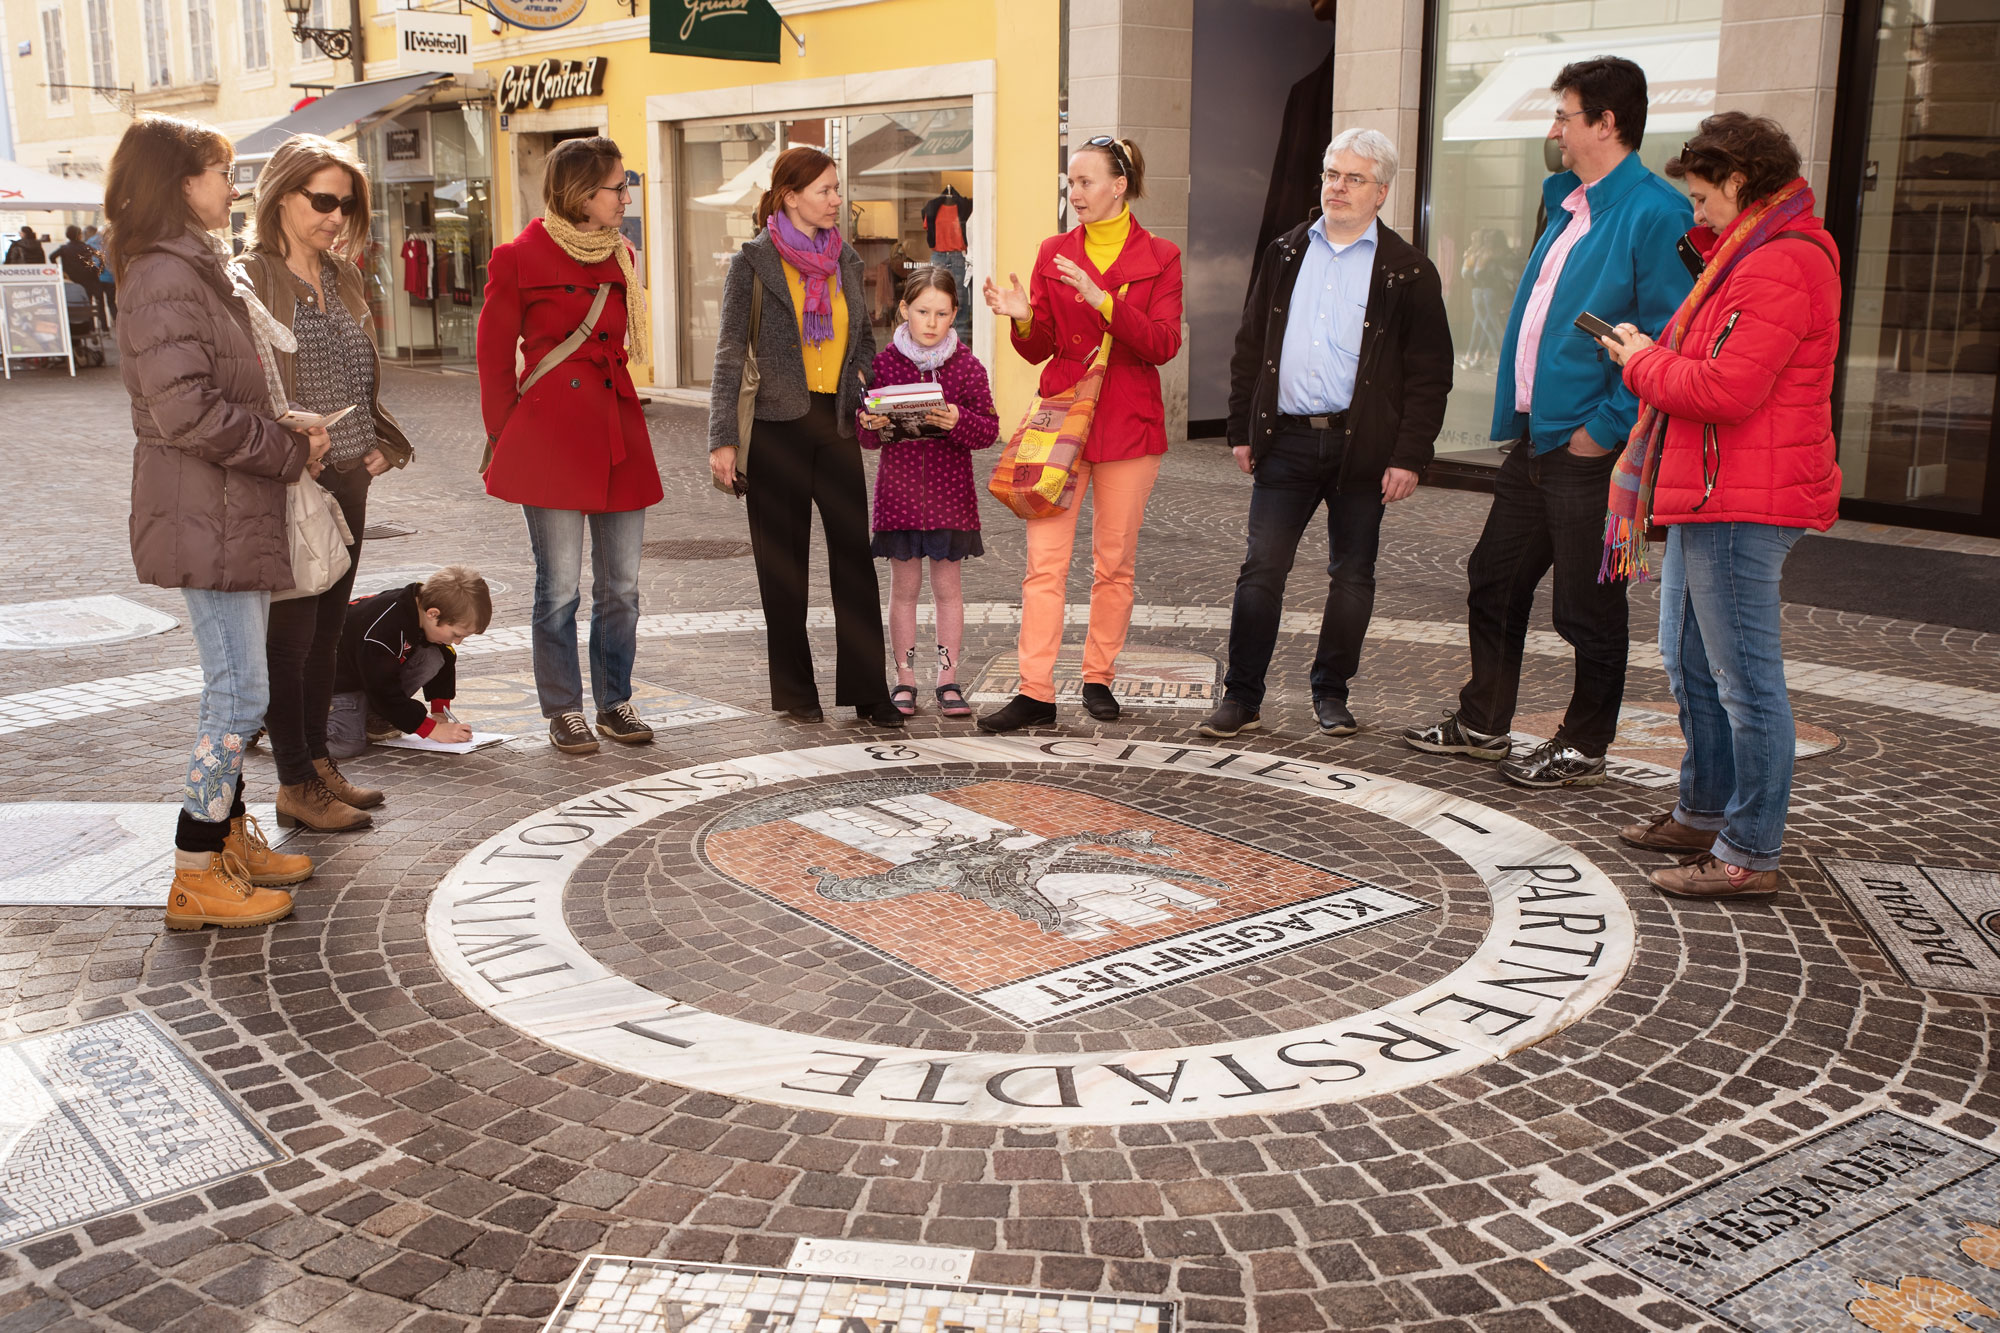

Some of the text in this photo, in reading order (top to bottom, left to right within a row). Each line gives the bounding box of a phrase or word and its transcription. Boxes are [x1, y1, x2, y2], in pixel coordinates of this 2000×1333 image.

[414, 35, 458, 50] Wolford
[532, 57, 598, 109] Central
[892, 401, 942, 410] Klagenfurt
[864, 743, 920, 762] &
[1039, 741, 1373, 792] CITIES
[480, 767, 750, 867] TOWNS
[452, 879, 575, 994] TWIN
[1035, 897, 1385, 1006] KLAGENFURT
[1859, 877, 1979, 971] DACHAU
[67, 1037, 213, 1166] GORIZIA
[1641, 1131, 1951, 1271] WIESBADEN
[804, 1247, 860, 1265] 1961
[891, 1255, 958, 1273] 2010
